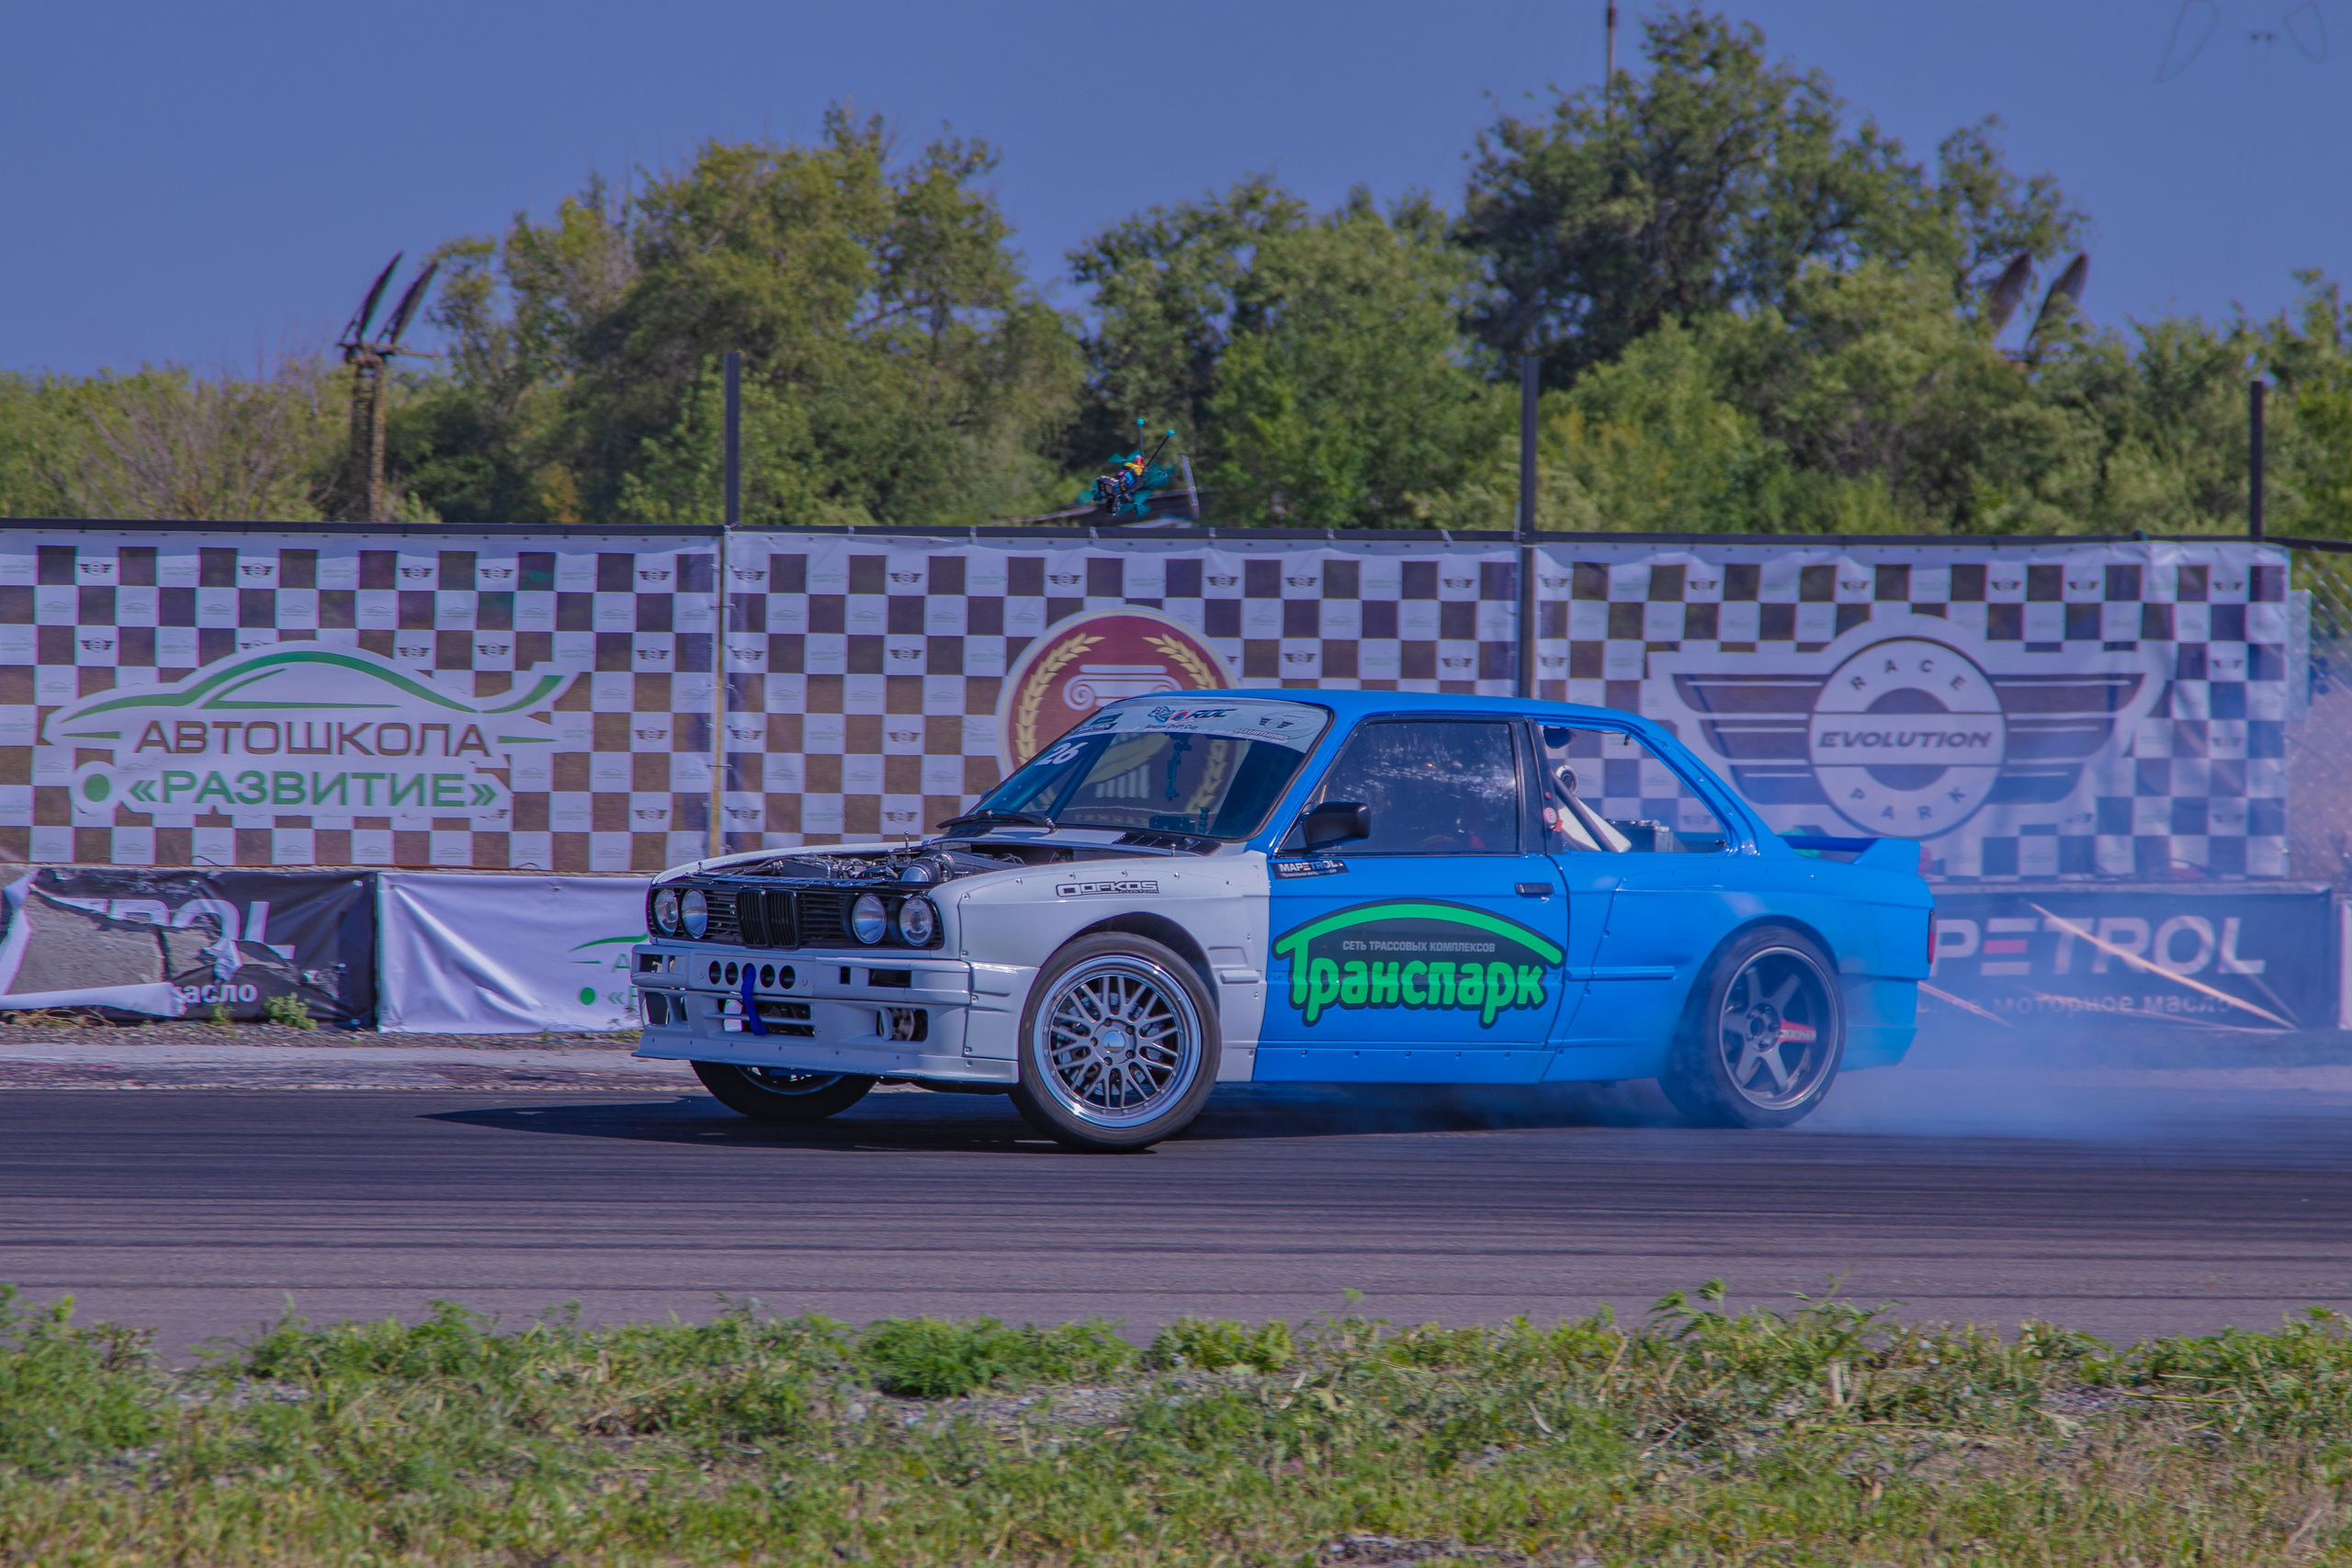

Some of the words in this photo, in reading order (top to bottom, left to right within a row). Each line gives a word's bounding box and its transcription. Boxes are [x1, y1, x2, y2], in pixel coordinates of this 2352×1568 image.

[1849, 660, 1966, 690] RACE
[134, 720, 492, 757] АВТОШКОЛА
[1035, 741, 1088, 766] 26
[1817, 731, 1994, 749] EVOLUTION
[130, 770, 499, 807] «РАЗВИТИЕ»
[1849, 787, 1966, 820] PARK
[1342, 941, 1367, 951] СЕТЬ
[1369, 941, 1427, 952] ТРАССОВЫХ
[1430, 942, 1496, 953] КОМПЛЕКСОВ
[1275, 904, 1563, 1024] Транспарк
